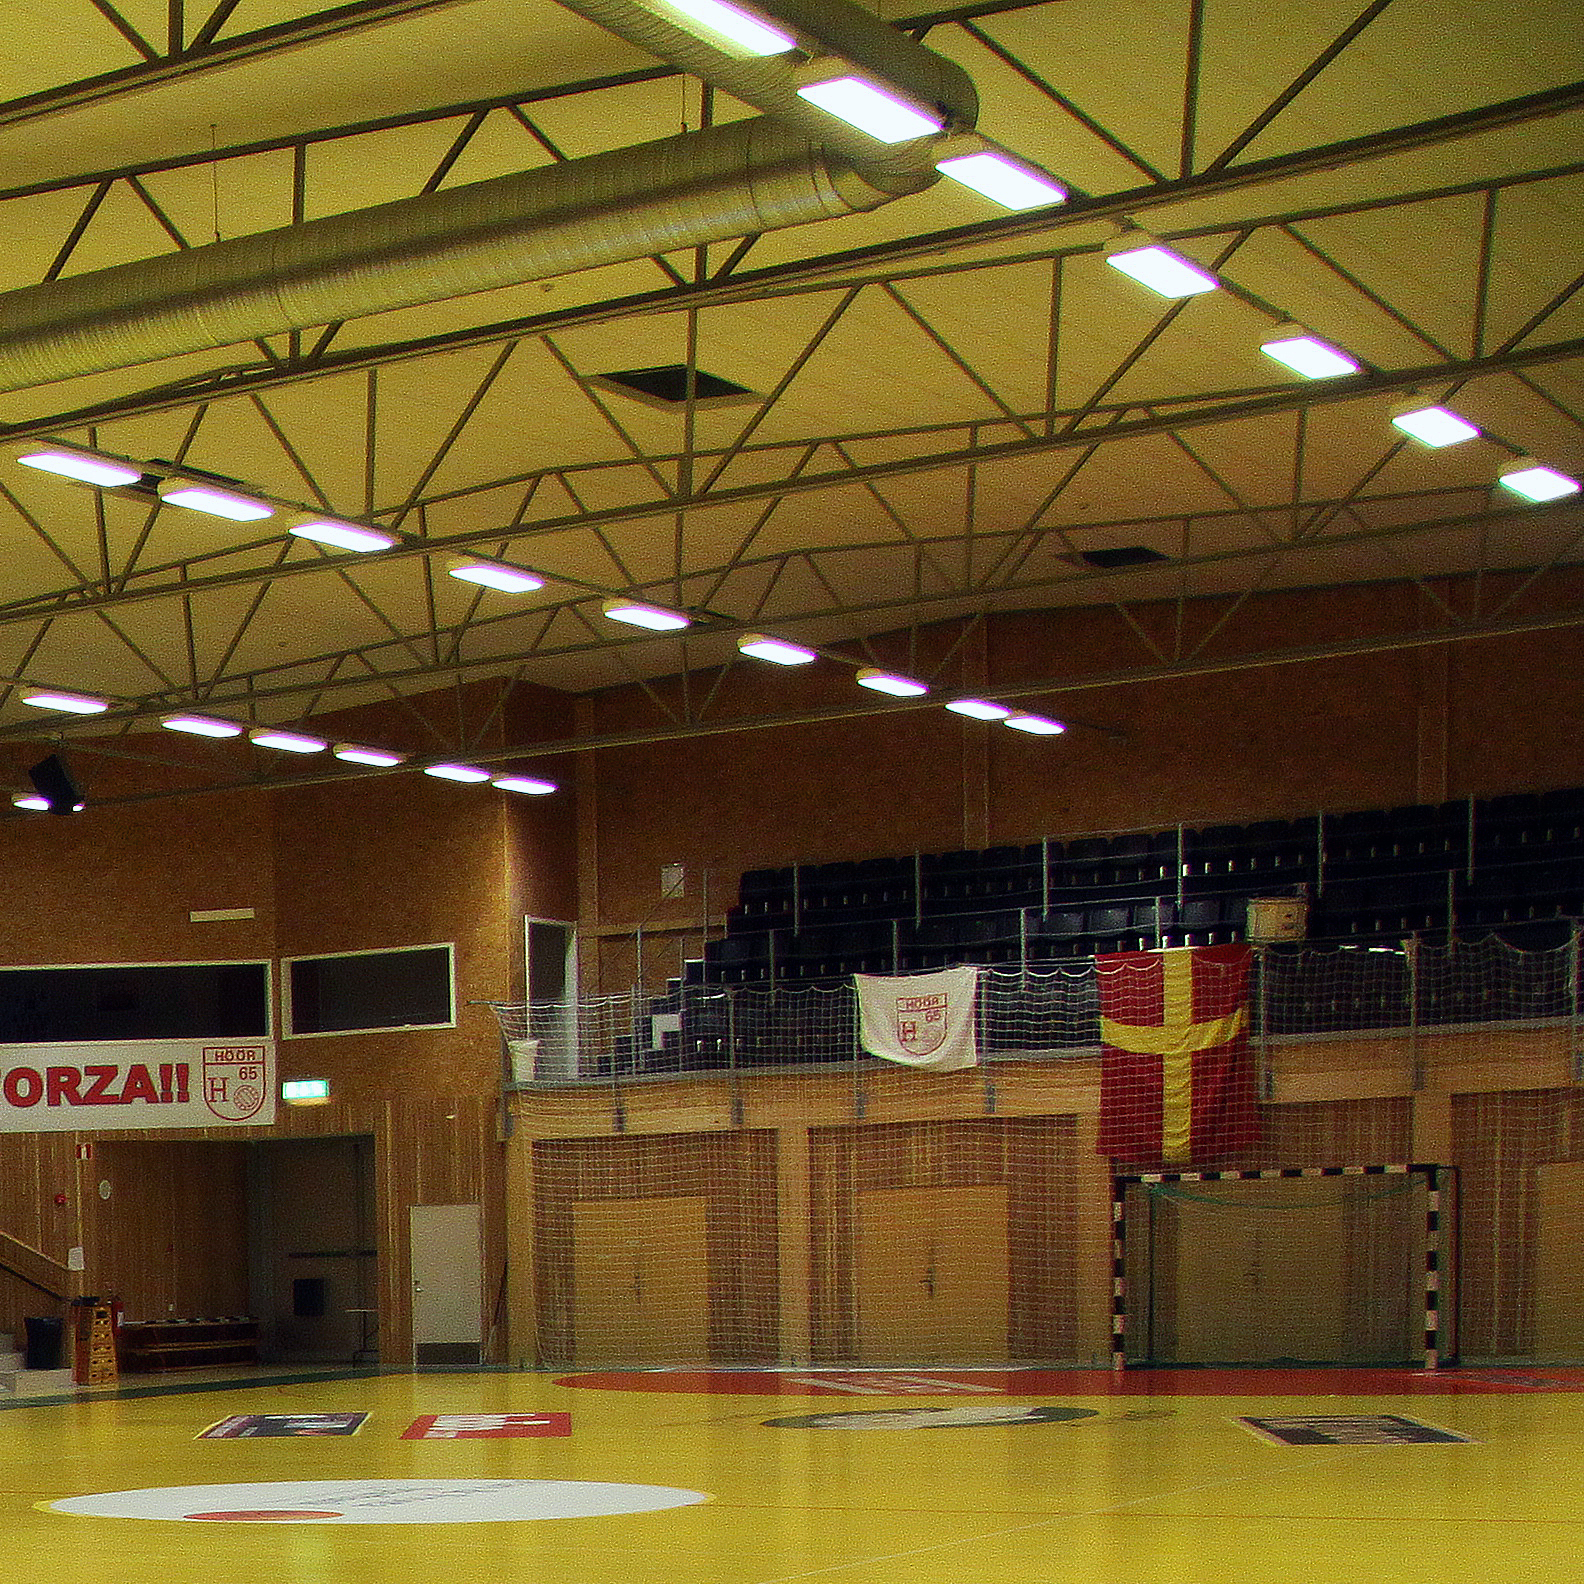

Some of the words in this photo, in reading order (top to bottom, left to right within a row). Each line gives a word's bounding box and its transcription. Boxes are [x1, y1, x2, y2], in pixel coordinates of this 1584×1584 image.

[215, 1049, 256, 1061] HÖÖR
[239, 1066, 257, 1080] 65
[207, 1077, 230, 1102] H
